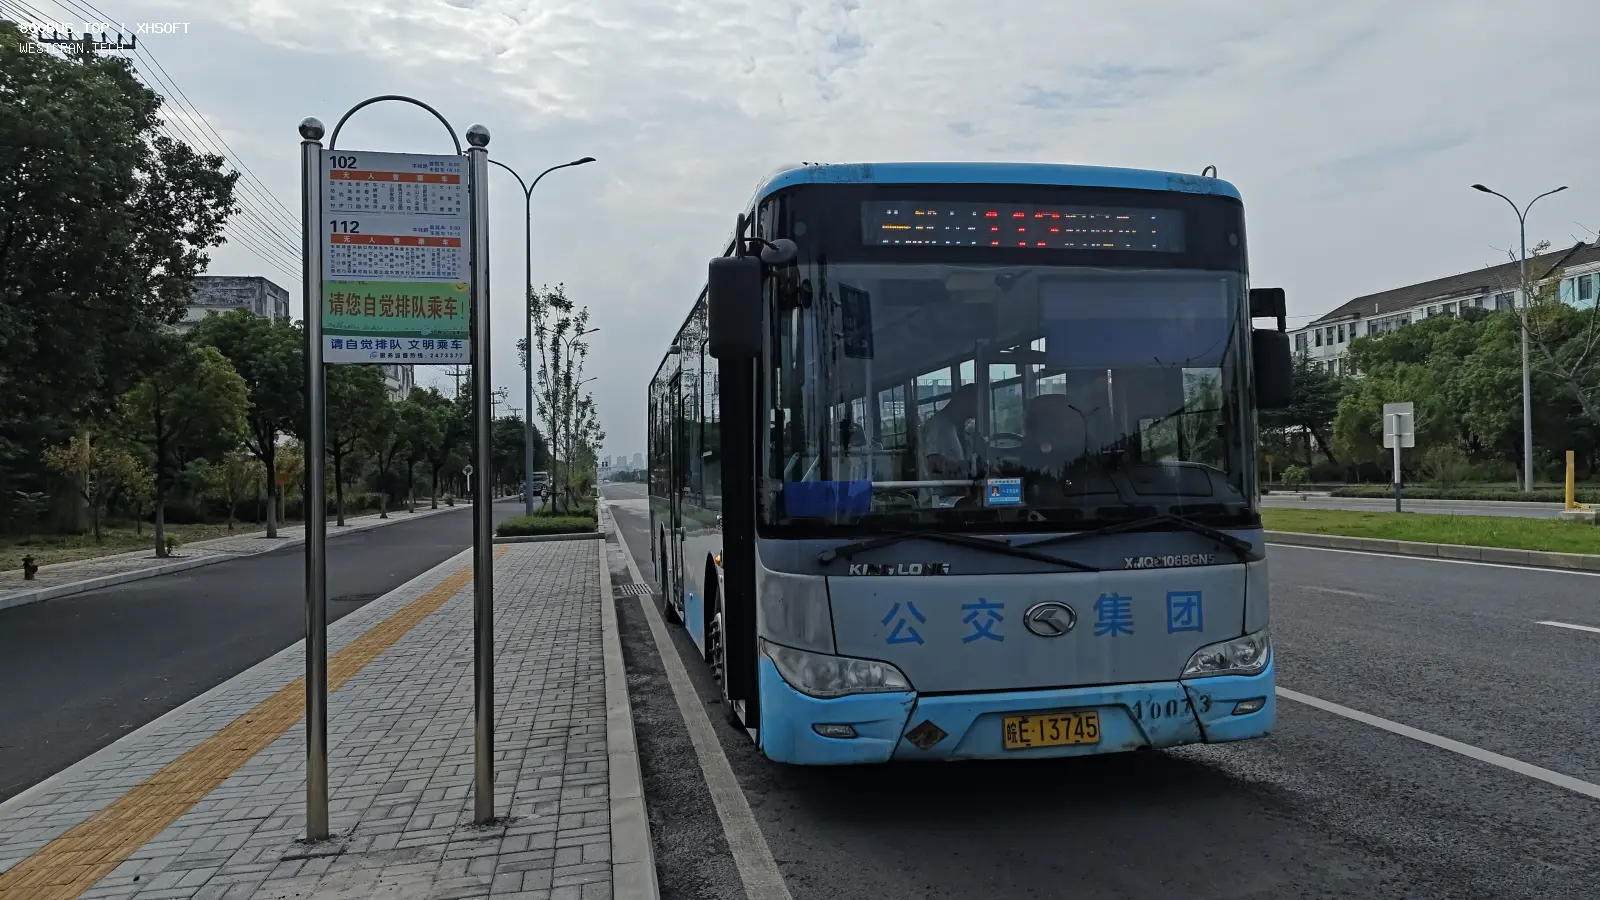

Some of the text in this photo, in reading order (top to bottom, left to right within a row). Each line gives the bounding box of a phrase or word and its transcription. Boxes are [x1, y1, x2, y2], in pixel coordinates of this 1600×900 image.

[329, 155, 357, 169] 102
[330, 220, 360, 234] 112
[331, 338, 463, 351] 请自觉排队 文明乘车
[880, 590, 1204, 646] 公交集团
